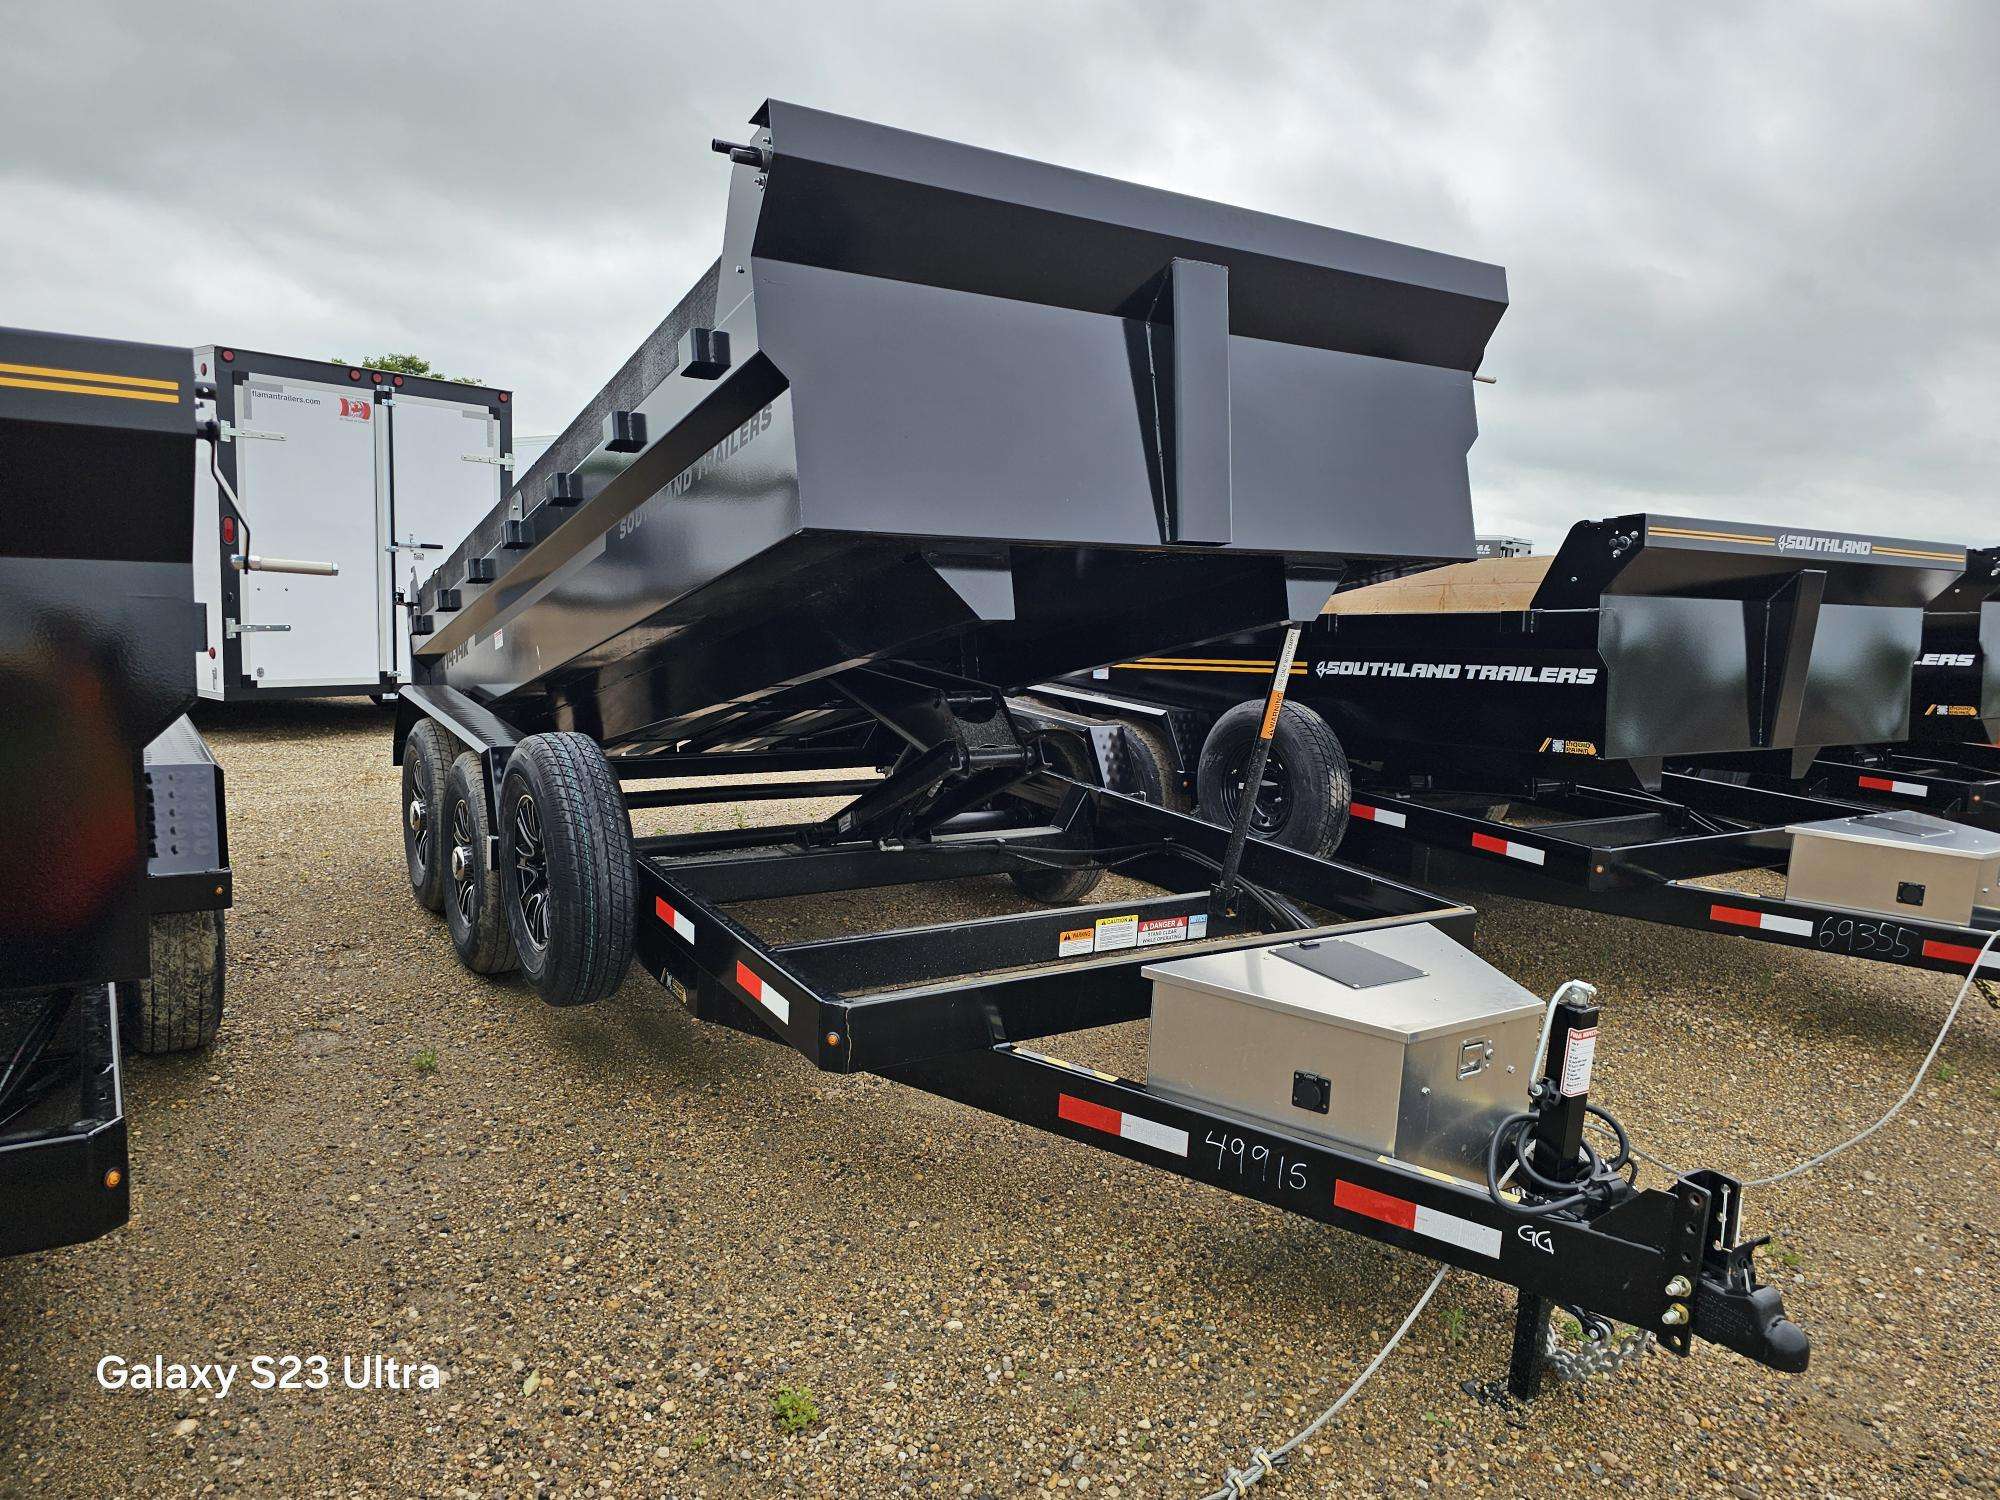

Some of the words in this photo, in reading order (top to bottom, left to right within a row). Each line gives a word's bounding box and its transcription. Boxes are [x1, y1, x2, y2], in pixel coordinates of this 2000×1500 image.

[252, 388, 320, 405] flamantrailers.com
[1785, 534, 1872, 556] SOUTHLAND
[1326, 661, 1460, 679] SOUTHLAND
[1465, 664, 1598, 685] TRAILERS
[1149, 920, 1176, 930] DANGER
[1819, 916, 1919, 957] 69355
[1205, 1130, 1307, 1189] 49915
[1518, 1225, 1554, 1254] GG
